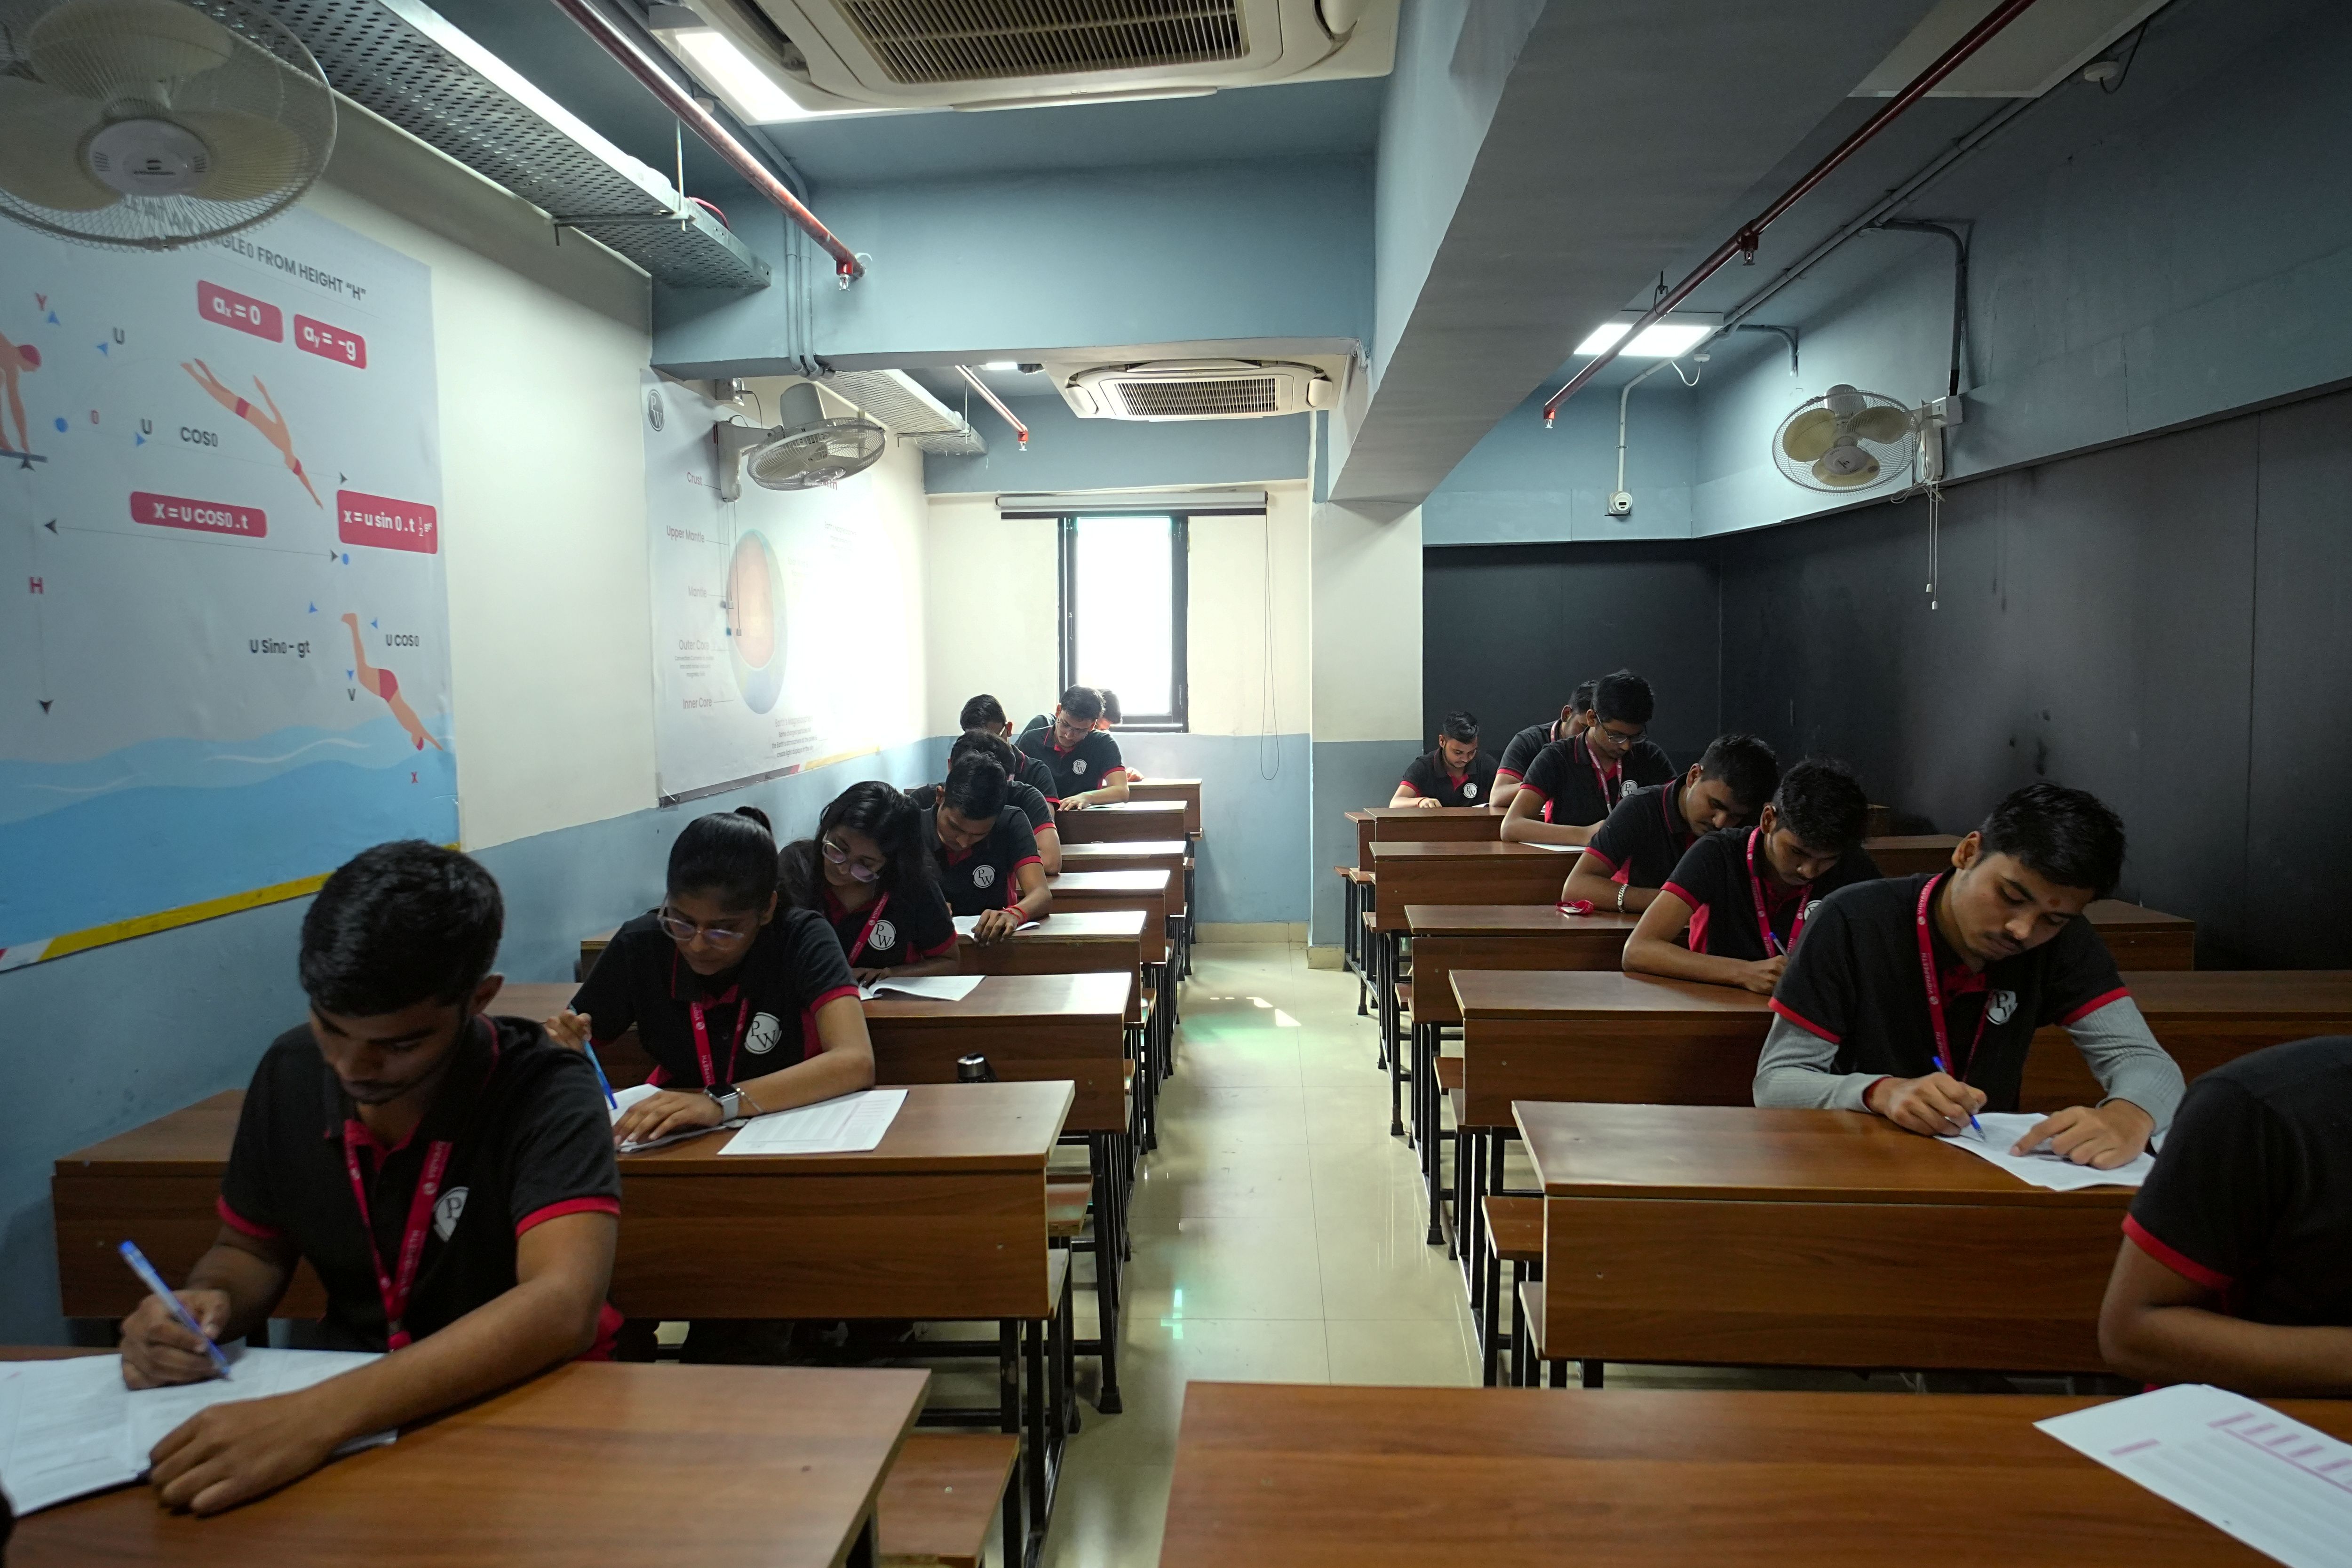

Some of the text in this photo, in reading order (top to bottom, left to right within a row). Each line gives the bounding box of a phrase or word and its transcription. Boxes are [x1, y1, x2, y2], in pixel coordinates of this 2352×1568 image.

[257, 247, 296, 275] FROM
[299, 263, 343, 293] HEIGHT
[35, 293, 48, 311] Y
[113, 327, 125, 345] U
[141, 418, 152, 435] U
[687, 472, 702, 486] Crust
[667, 525, 705, 542] Upper Mantle
[30, 577, 44, 594] H
[688, 586, 707, 597] Mantle
[249, 639, 259, 653] U
[386, 634, 392, 646] U
[679, 639, 709, 650] Outer Core
[347, 688, 356, 701] V
[683, 697, 712, 709] Inner Core
